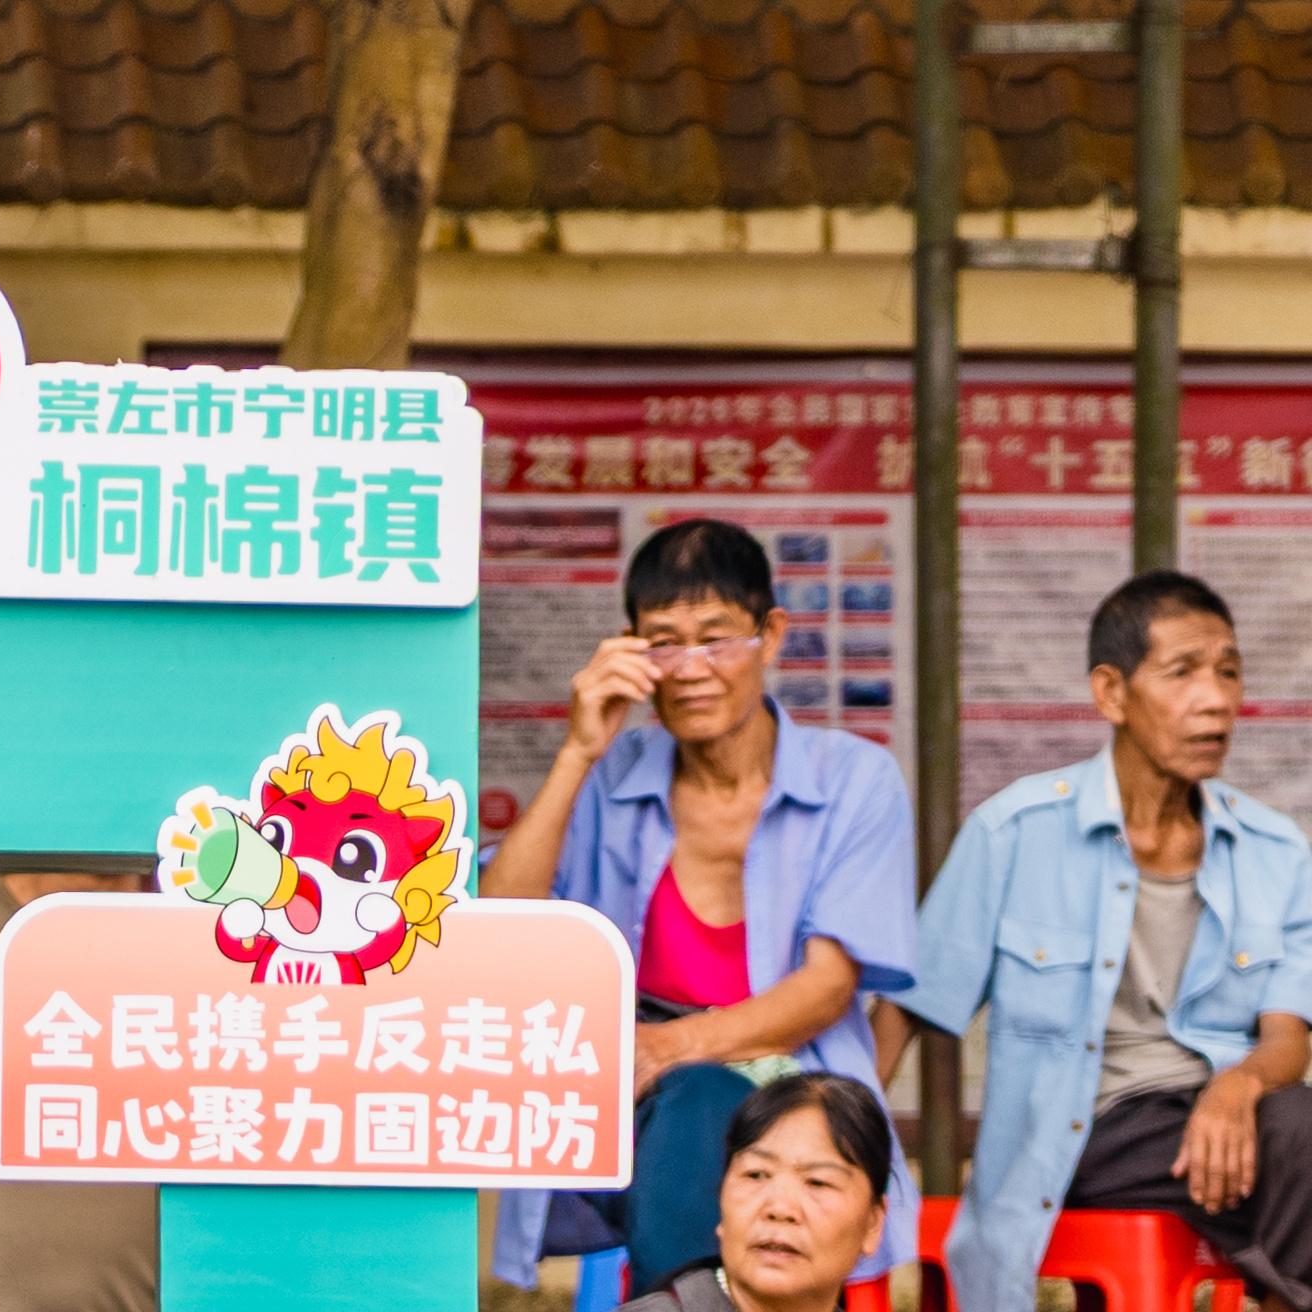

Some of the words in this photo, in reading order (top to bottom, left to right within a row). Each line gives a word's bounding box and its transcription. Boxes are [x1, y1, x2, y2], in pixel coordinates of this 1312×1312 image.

[37, 380, 443, 442] 崇左市宁明县
[28, 460, 443, 583] 桐棉镇
[23, 990, 600, 1076] 全民携手反走私
[23, 1082, 600, 1170] 同心聚力固边防
